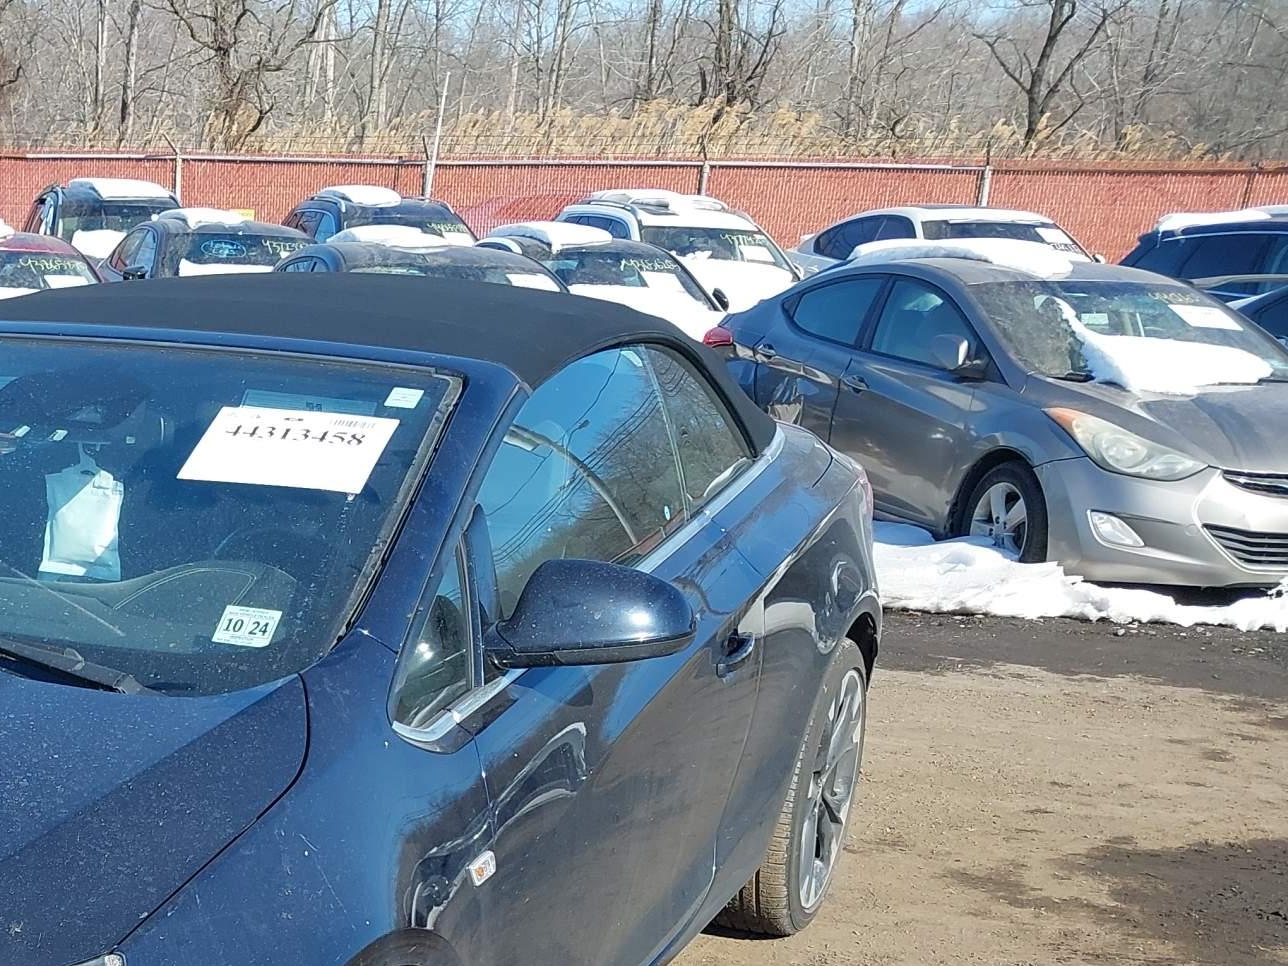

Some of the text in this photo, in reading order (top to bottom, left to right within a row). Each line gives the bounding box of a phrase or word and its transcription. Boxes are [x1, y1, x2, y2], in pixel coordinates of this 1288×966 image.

[225, 424, 366, 447] 44313458
[223, 617, 270, 637] 10 24
